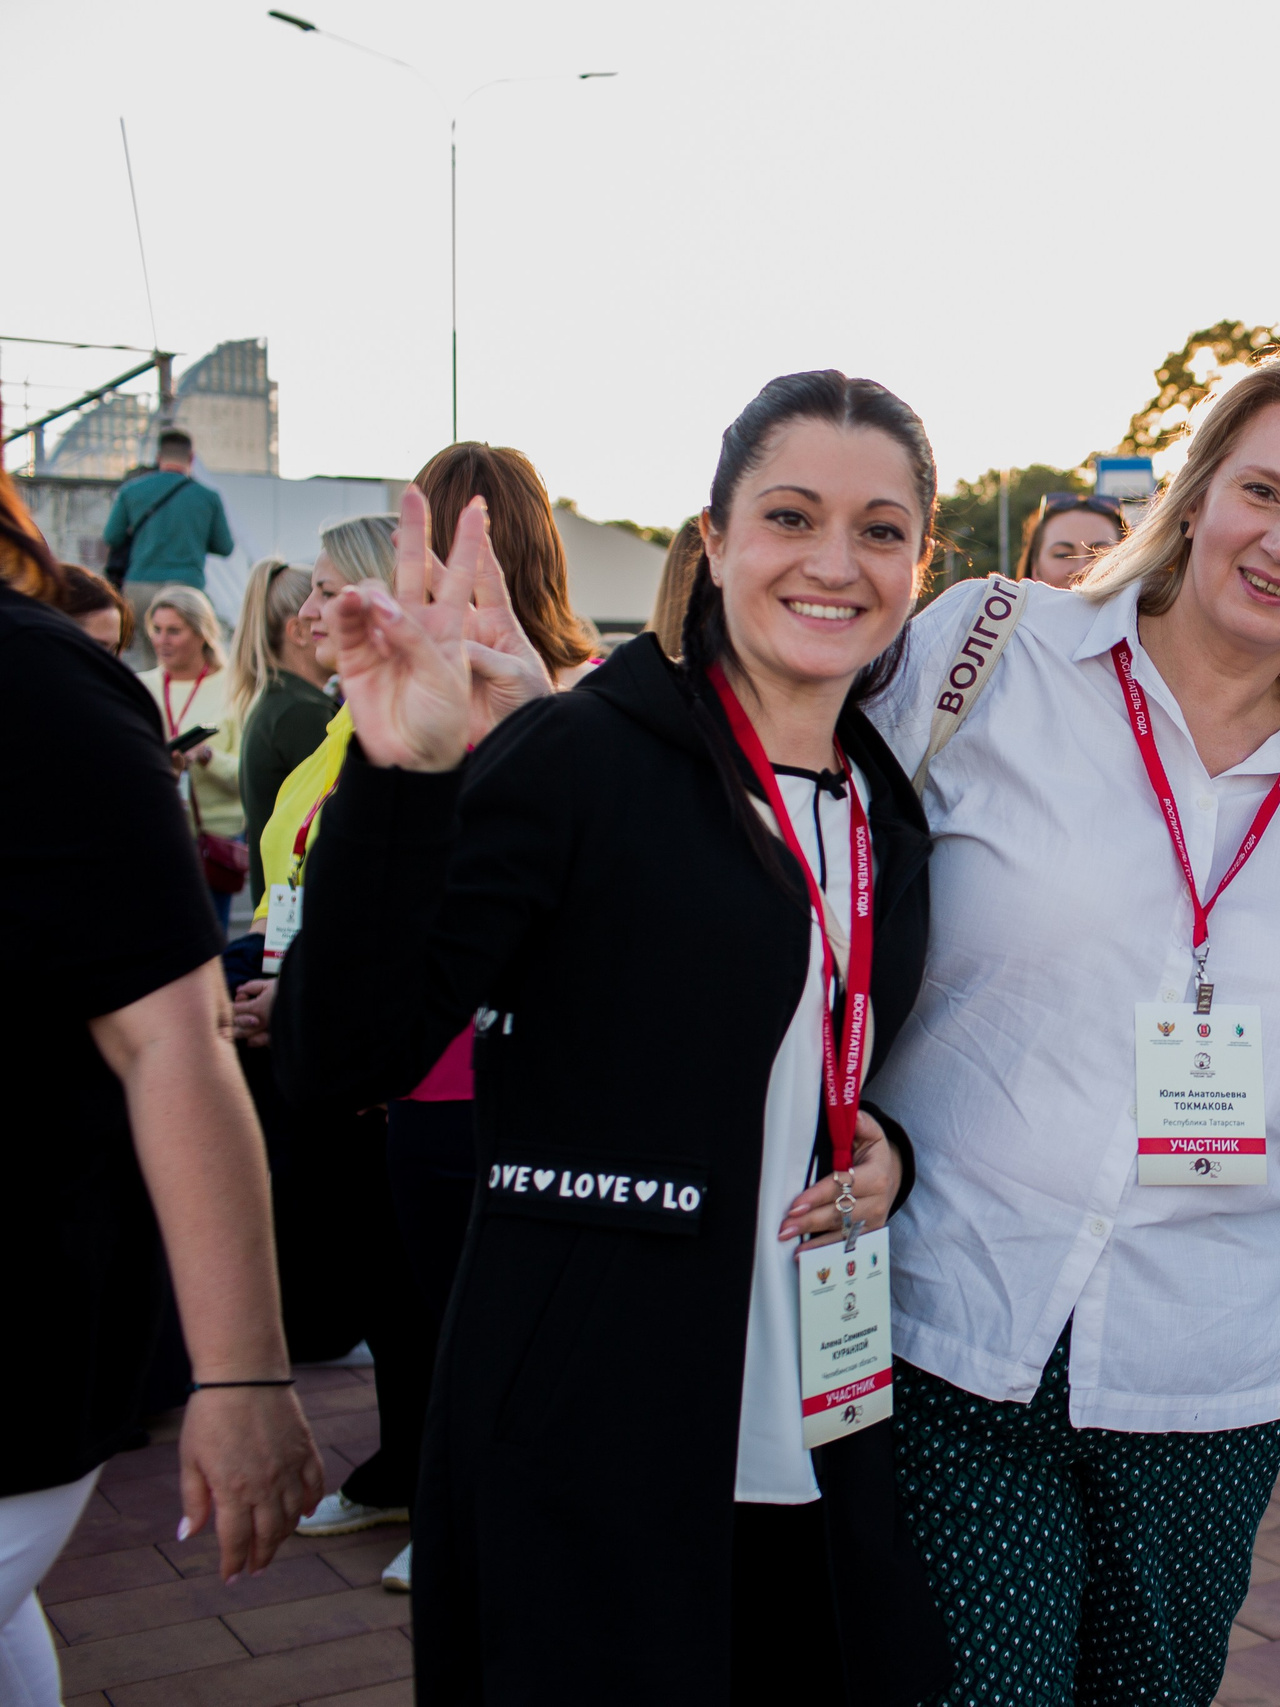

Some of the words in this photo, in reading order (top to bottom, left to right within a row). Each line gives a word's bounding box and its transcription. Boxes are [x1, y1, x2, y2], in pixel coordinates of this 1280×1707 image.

[936, 578, 1019, 715] ВОЛГОГ
[1136, 711, 1148, 736] ГОДА
[856, 825, 868, 890] ВОСПИТАТЕЛЬ
[1244, 834, 1256, 854] ГОДА
[858, 891, 868, 918] ГОДА
[846, 993, 865, 1074] ВОСПИТАТЕЛЬ
[844, 1074, 857, 1106] ГОДА
[1160, 1089, 1186, 1098] Юлия
[1188, 1090, 1247, 1098] Анатольевна
[1174, 1102, 1234, 1111] ТОКМАКОВА
[1163, 1118, 1207, 1128] Республика
[1209, 1118, 1245, 1127] Татарстан
[1170, 1139, 1240, 1152] УЧАСТНИК
[559, 1170, 632, 1202] LOVE
[826, 1376, 876, 1407] УЧАСТНИК
